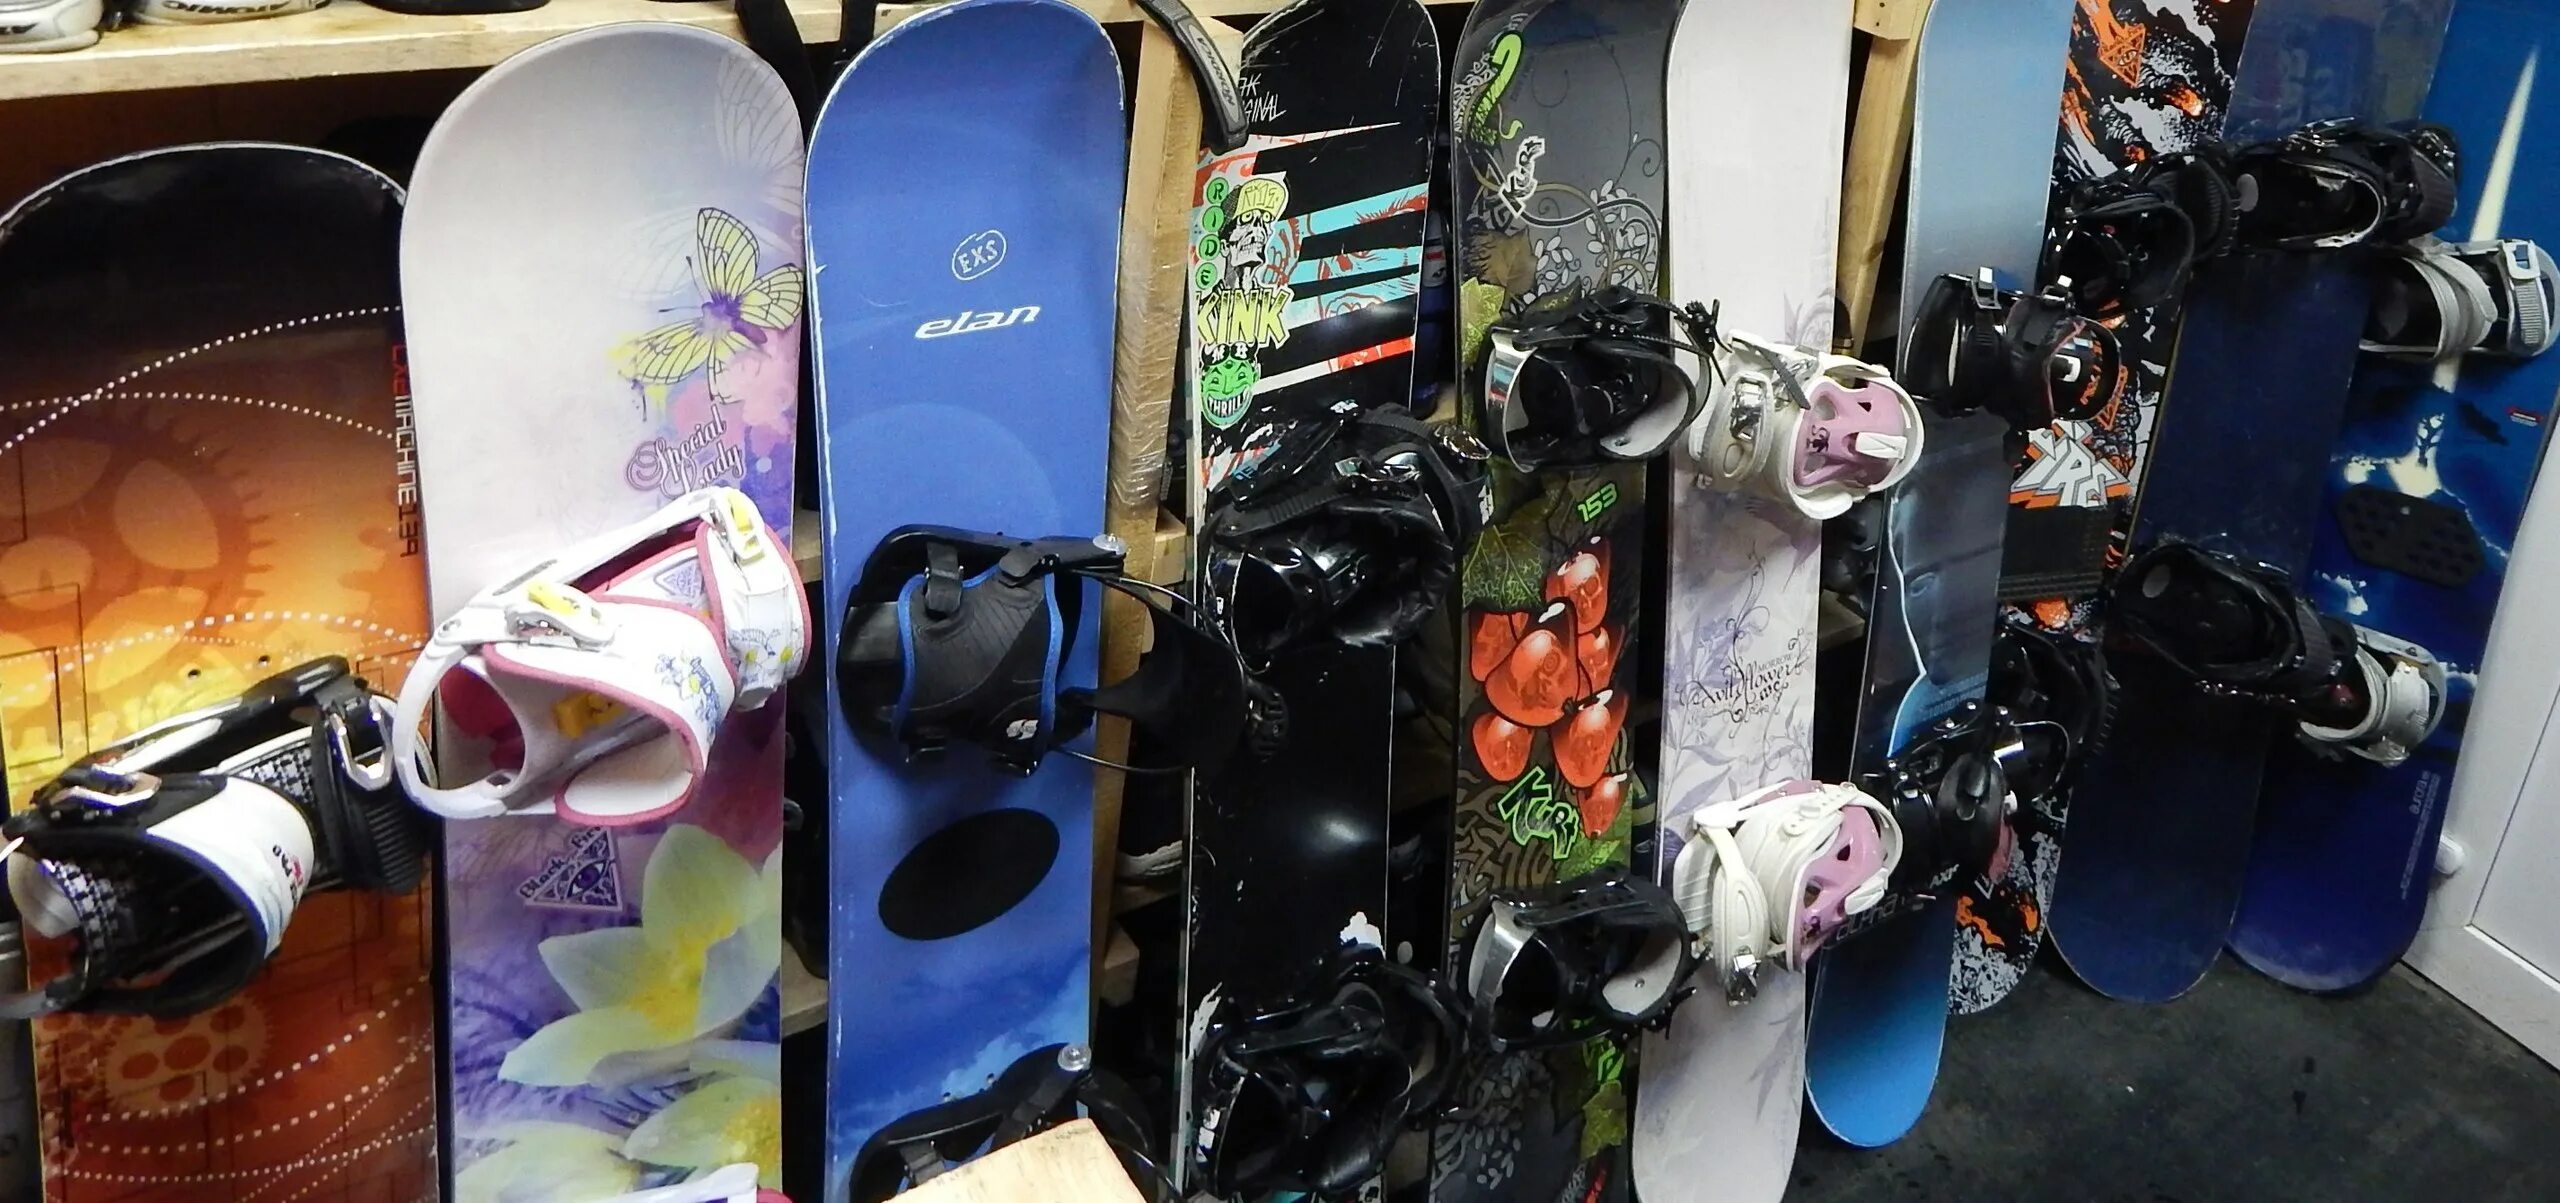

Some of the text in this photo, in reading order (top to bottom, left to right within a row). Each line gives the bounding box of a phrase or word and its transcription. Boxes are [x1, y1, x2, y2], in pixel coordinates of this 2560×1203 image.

[957, 239, 998, 273] EXS
[914, 306, 1041, 339] elan
[1577, 482, 1617, 522] 153
